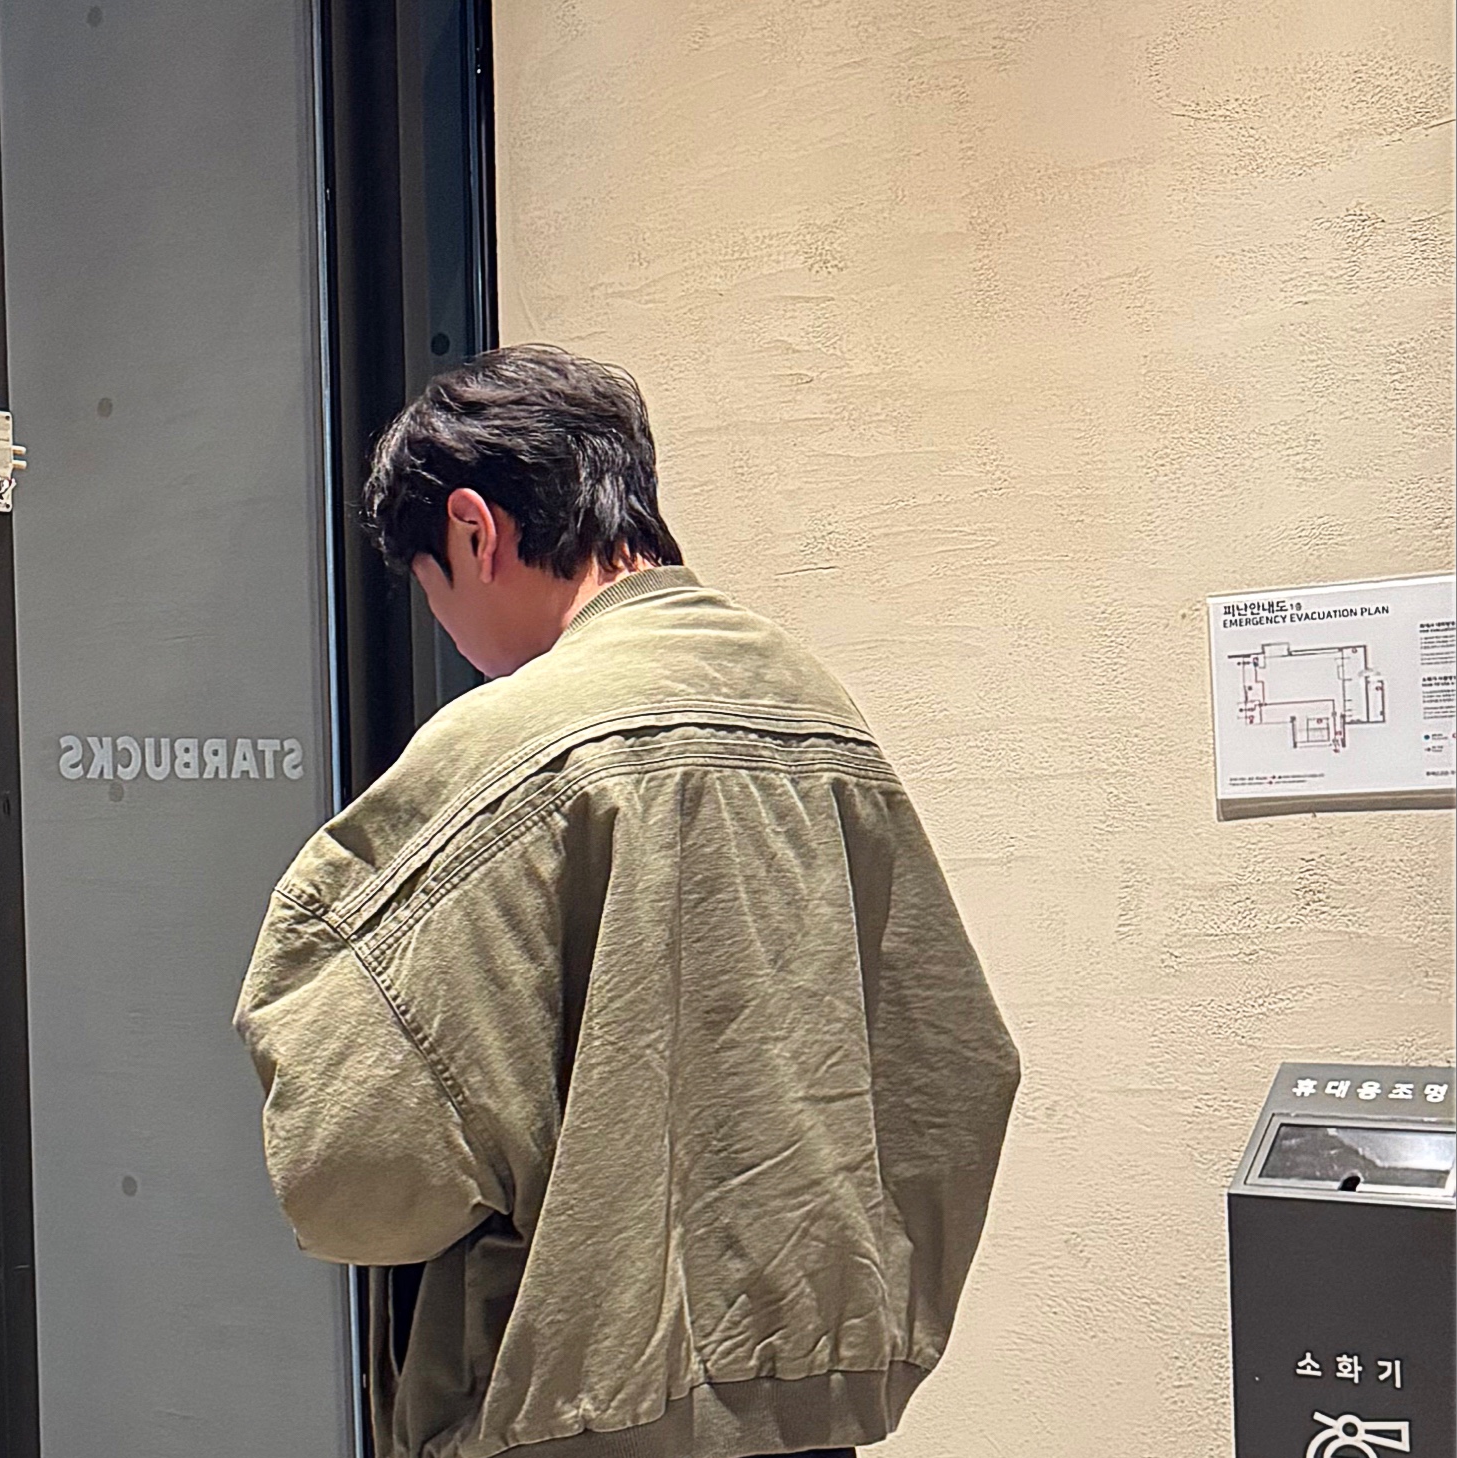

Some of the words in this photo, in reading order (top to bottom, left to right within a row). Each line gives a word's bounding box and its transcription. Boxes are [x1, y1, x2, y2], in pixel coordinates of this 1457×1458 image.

[1223, 600, 1288, 617] 피난안내도
[1223, 614, 1287, 628] EMERGENCY
[1290, 608, 1357, 623] EVACUATION
[1360, 605, 1389, 617] PLAN
